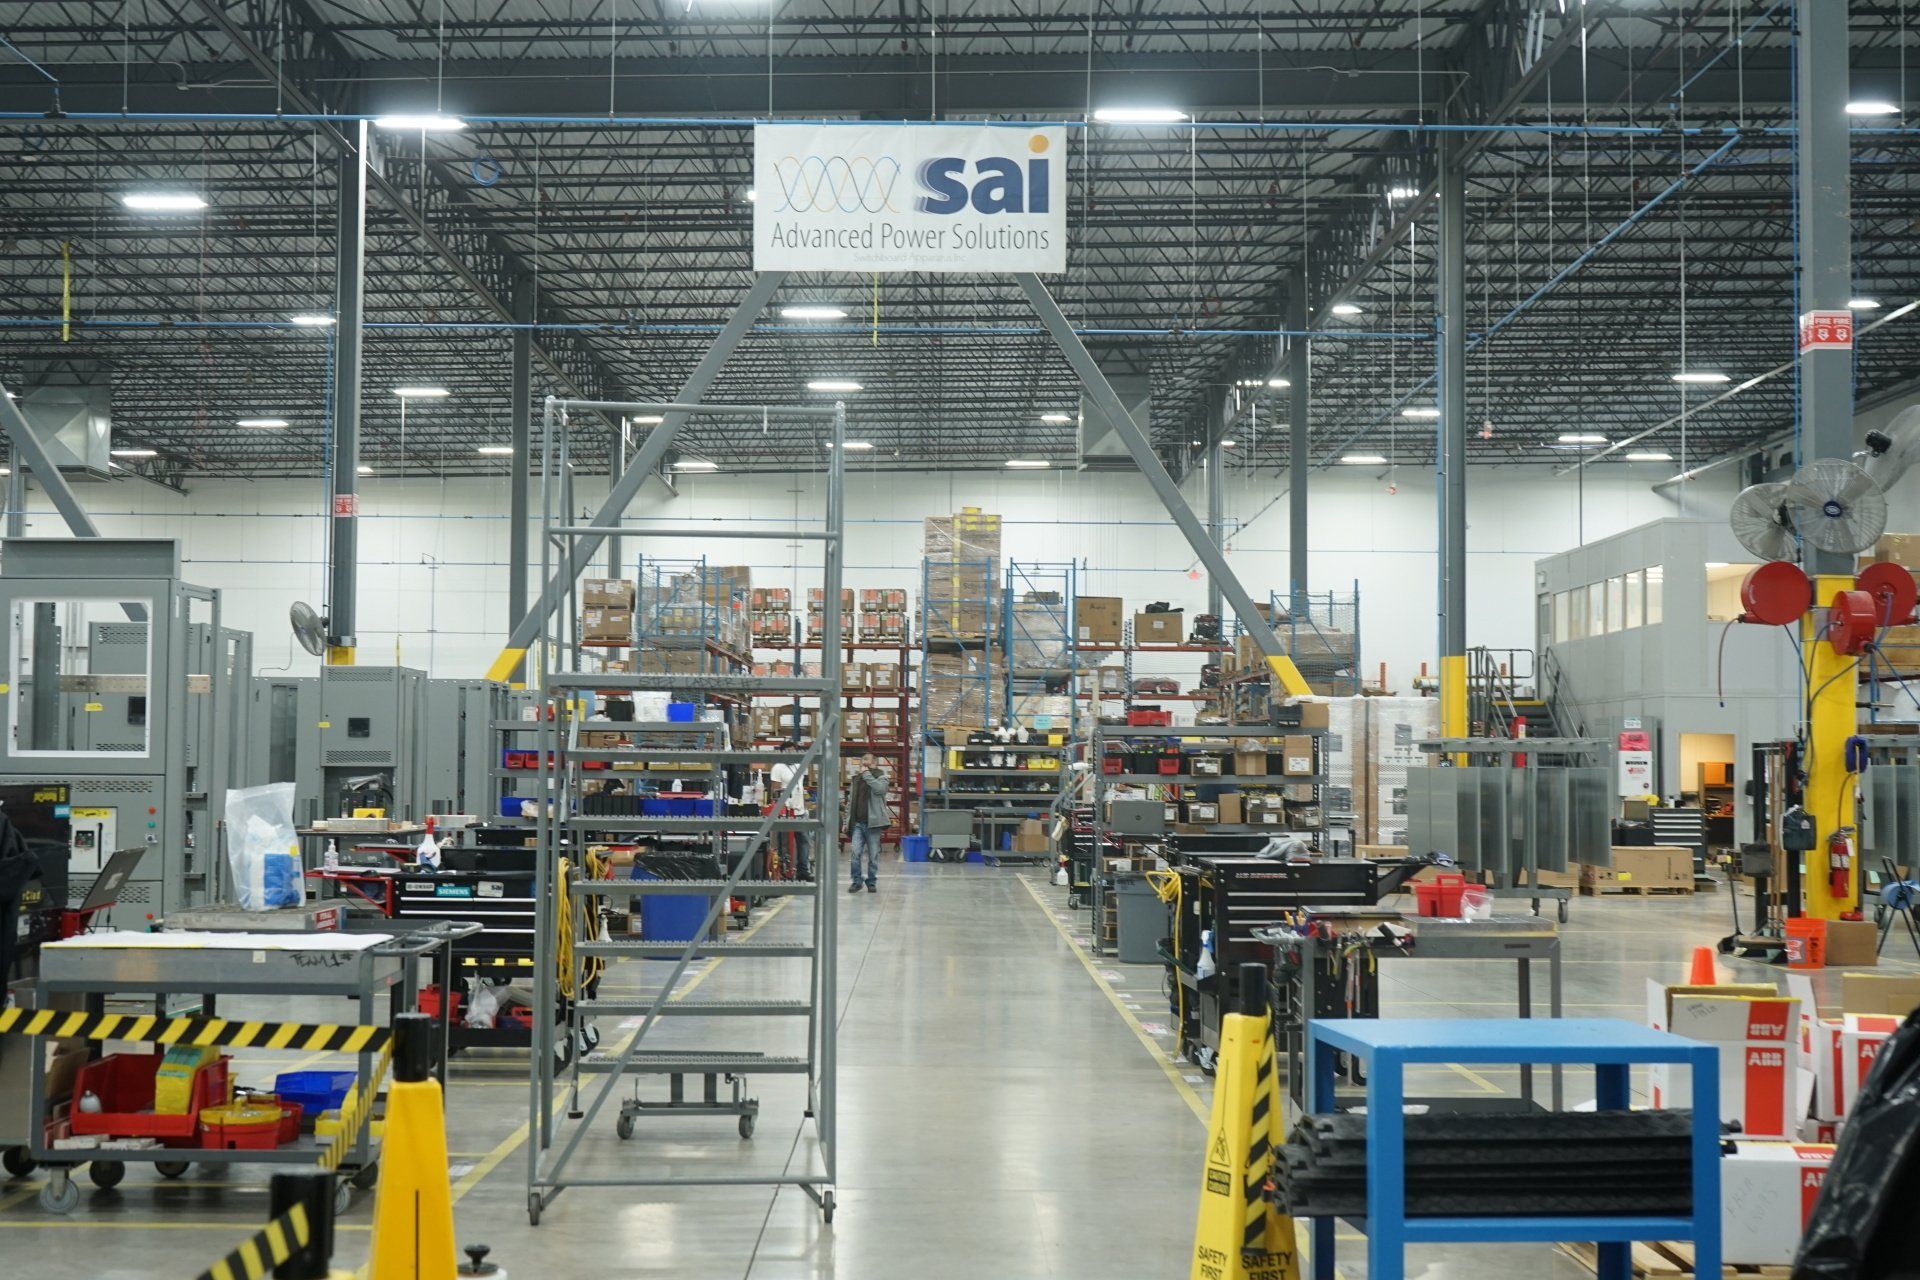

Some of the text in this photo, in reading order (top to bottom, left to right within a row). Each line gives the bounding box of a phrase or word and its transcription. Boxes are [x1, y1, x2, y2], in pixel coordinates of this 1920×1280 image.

[915, 134, 1050, 215] sai
[771, 222, 1050, 250] Advanced Power Solutions
[1749, 1023, 1785, 1038] ABB
[1748, 1052, 1783, 1067] ABB
[1198, 1245, 1228, 1266] SAFETY
[1242, 1253, 1292, 1269] SAFETY
[1200, 1264, 1222, 1280] FIRST
[1249, 1269, 1286, 1280] FIRST
